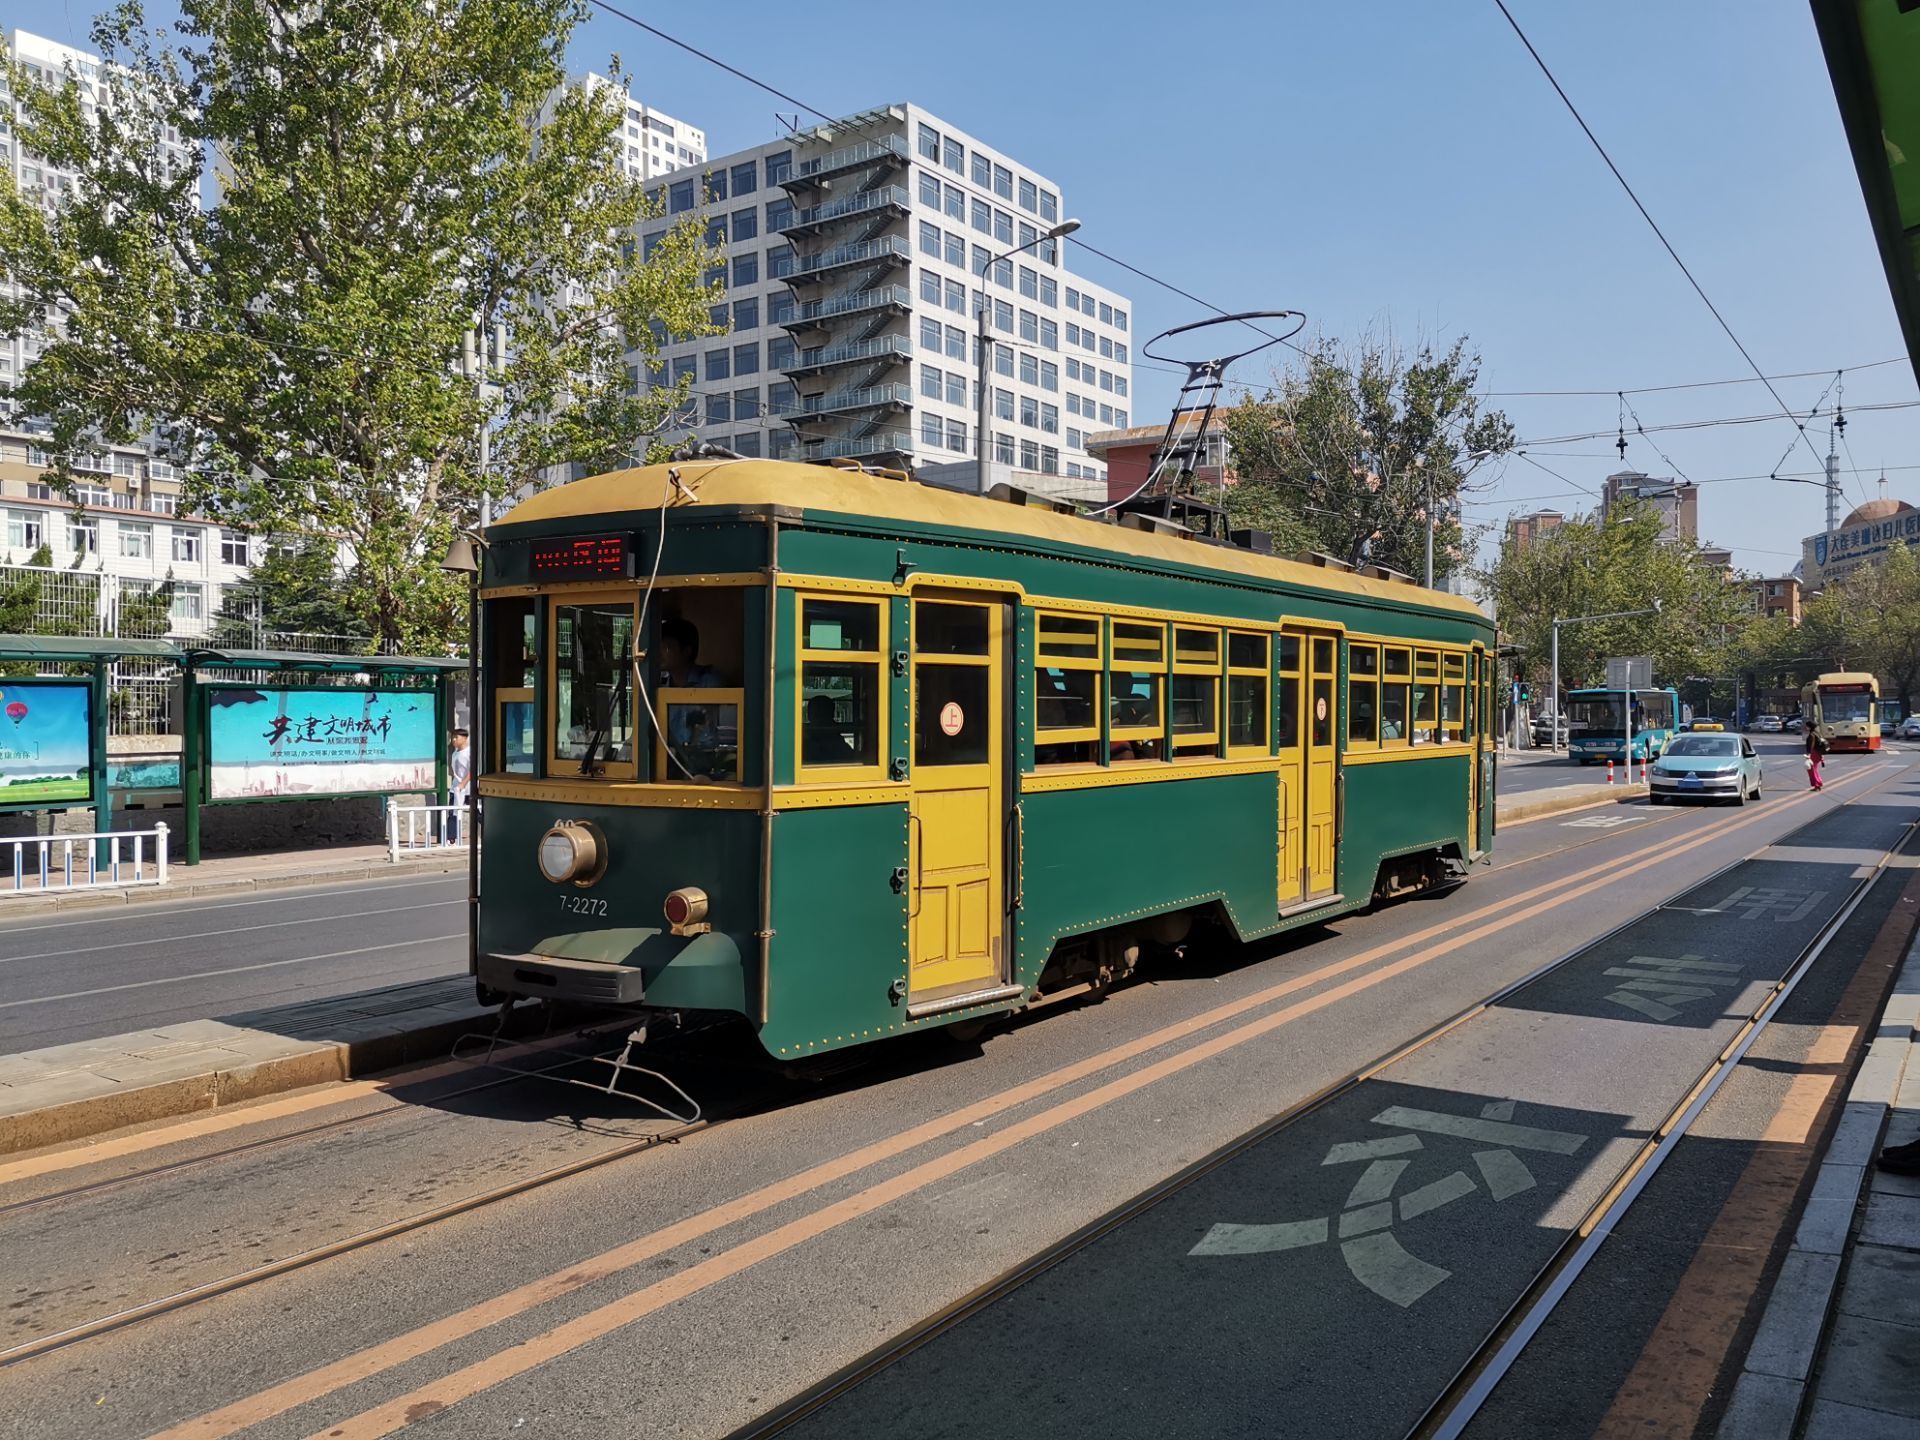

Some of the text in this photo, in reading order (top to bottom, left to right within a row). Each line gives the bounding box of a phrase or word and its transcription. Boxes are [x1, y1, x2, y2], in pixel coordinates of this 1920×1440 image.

[262, 711, 391, 745] 共建文明城市
[944, 708, 959, 728] 上
[559, 895, 608, 917] 7-2272
[1187, 1100, 1589, 1309] 交
